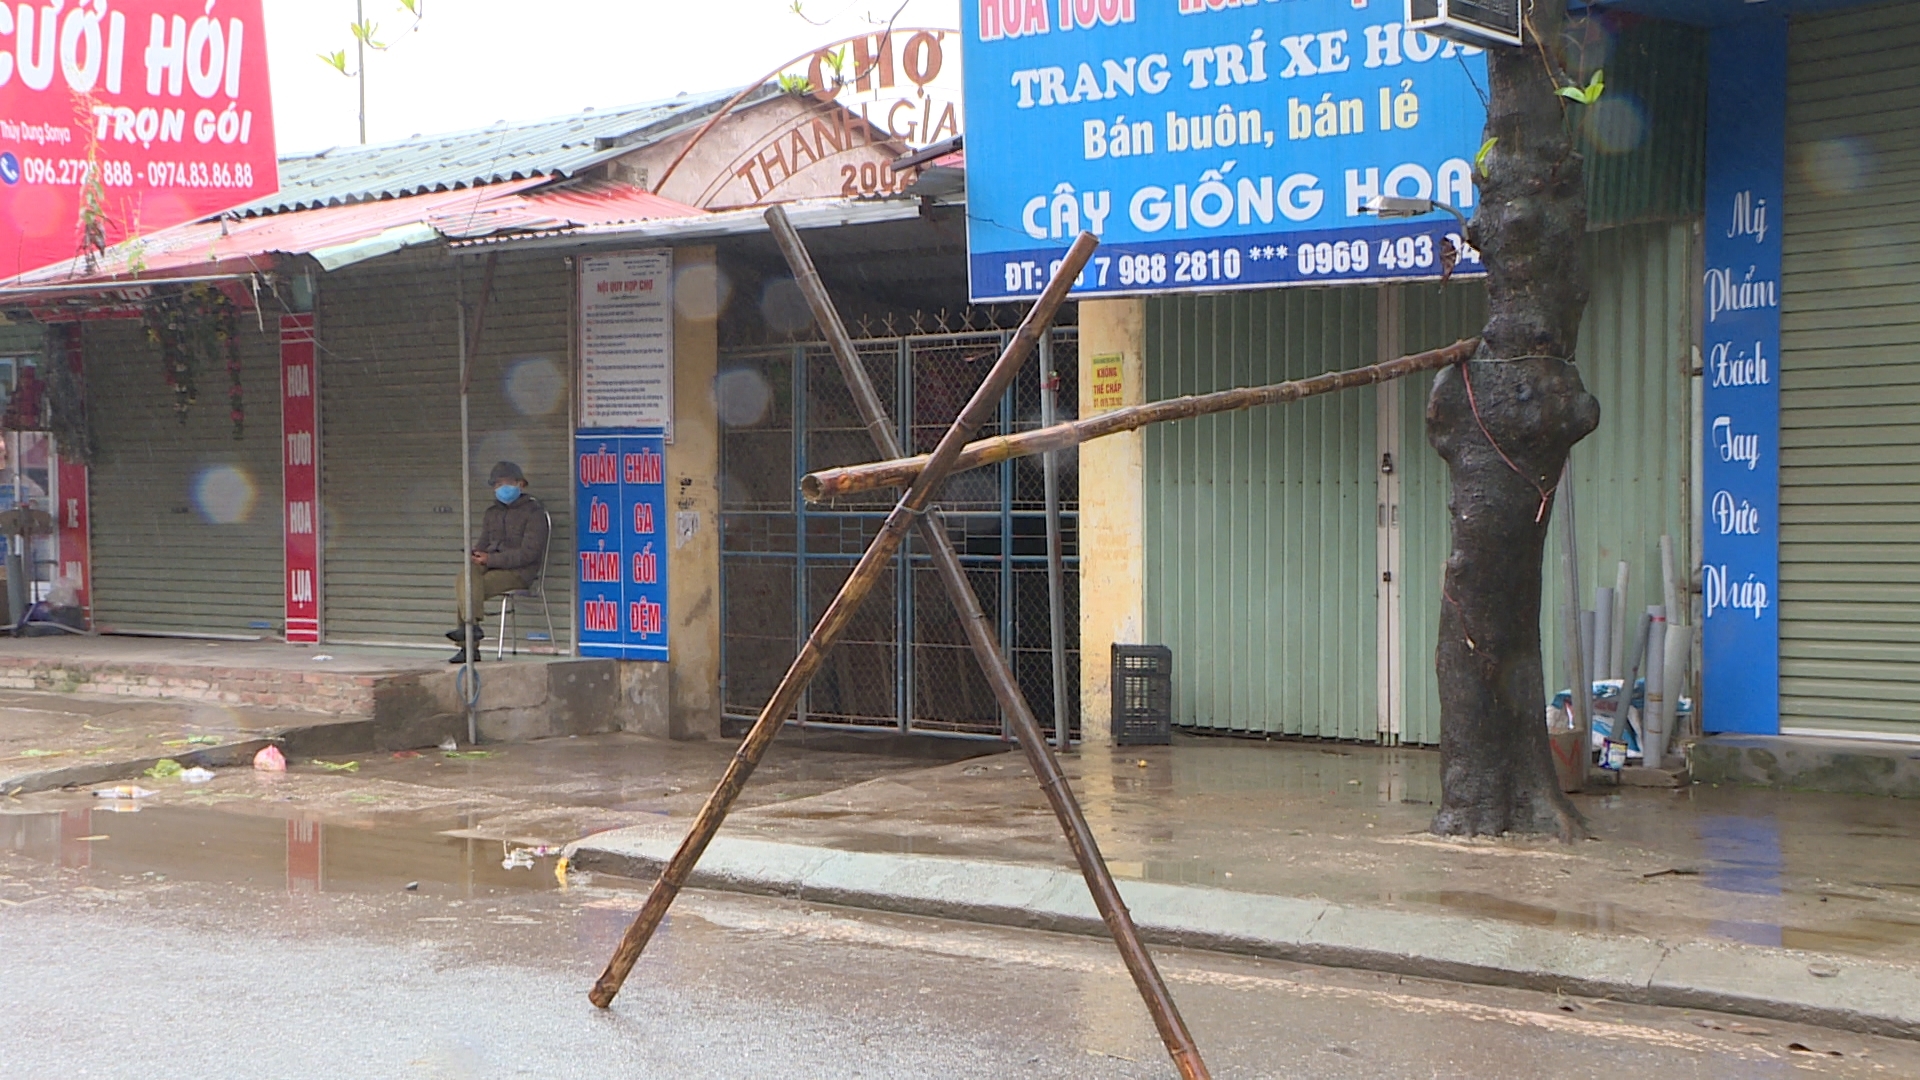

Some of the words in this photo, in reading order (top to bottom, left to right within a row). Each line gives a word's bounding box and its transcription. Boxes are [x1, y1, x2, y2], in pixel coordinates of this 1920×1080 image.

[807, 30, 945, 101] CHỢ
[1011, 53, 1171, 108] TRANG
[1182, 28, 1267, 90] TRÍ
[1279, 29, 1350, 79] XE
[20, 121, 45, 146] Dung
[92, 105, 186, 149] TRỌN
[194, 102, 252, 144] GÓI
[1083, 115, 1155, 160] Bán
[1166, 103, 1274, 152] buôn,
[1288, 92, 1364, 140] bán
[1379, 79, 1419, 131] lẻ
[737, 102, 873, 199] THANH
[149, 161, 253, 188] 0974.83.86.88
[1022, 182, 1111, 239] CÂY
[1129, 160, 1324, 233] GIỐNG
[1345, 158, 1474, 217] HOA
[1727, 190, 1768, 244] Mỹ
[1004, 260, 1043, 292] ĐT:
[1118, 253, 1167, 286] 988
[1174, 247, 1241, 282] 2810
[1297, 240, 1369, 275] 0969
[1377, 235, 1434, 270] 493
[1703, 265, 1778, 322] Phẩm
[287, 364, 310, 397] HOA
[1096, 365, 1117, 378] KHÔNG
[1710, 341, 1770, 388] Xách
[624, 447, 662, 484] CHĂN
[1712, 416, 1760, 470] Tay
[290, 501, 313, 534] HOA
[589, 496, 609, 533] ÁO
[634, 503, 655, 533] GA
[1712, 490, 1760, 535] Đức
[580, 539, 620, 582] THẢM
[633, 542, 658, 583] GỐI
[291, 570, 313, 608] LỤA
[1702, 565, 1768, 619] Pháp
[630, 595, 662, 639] ĐỆM
